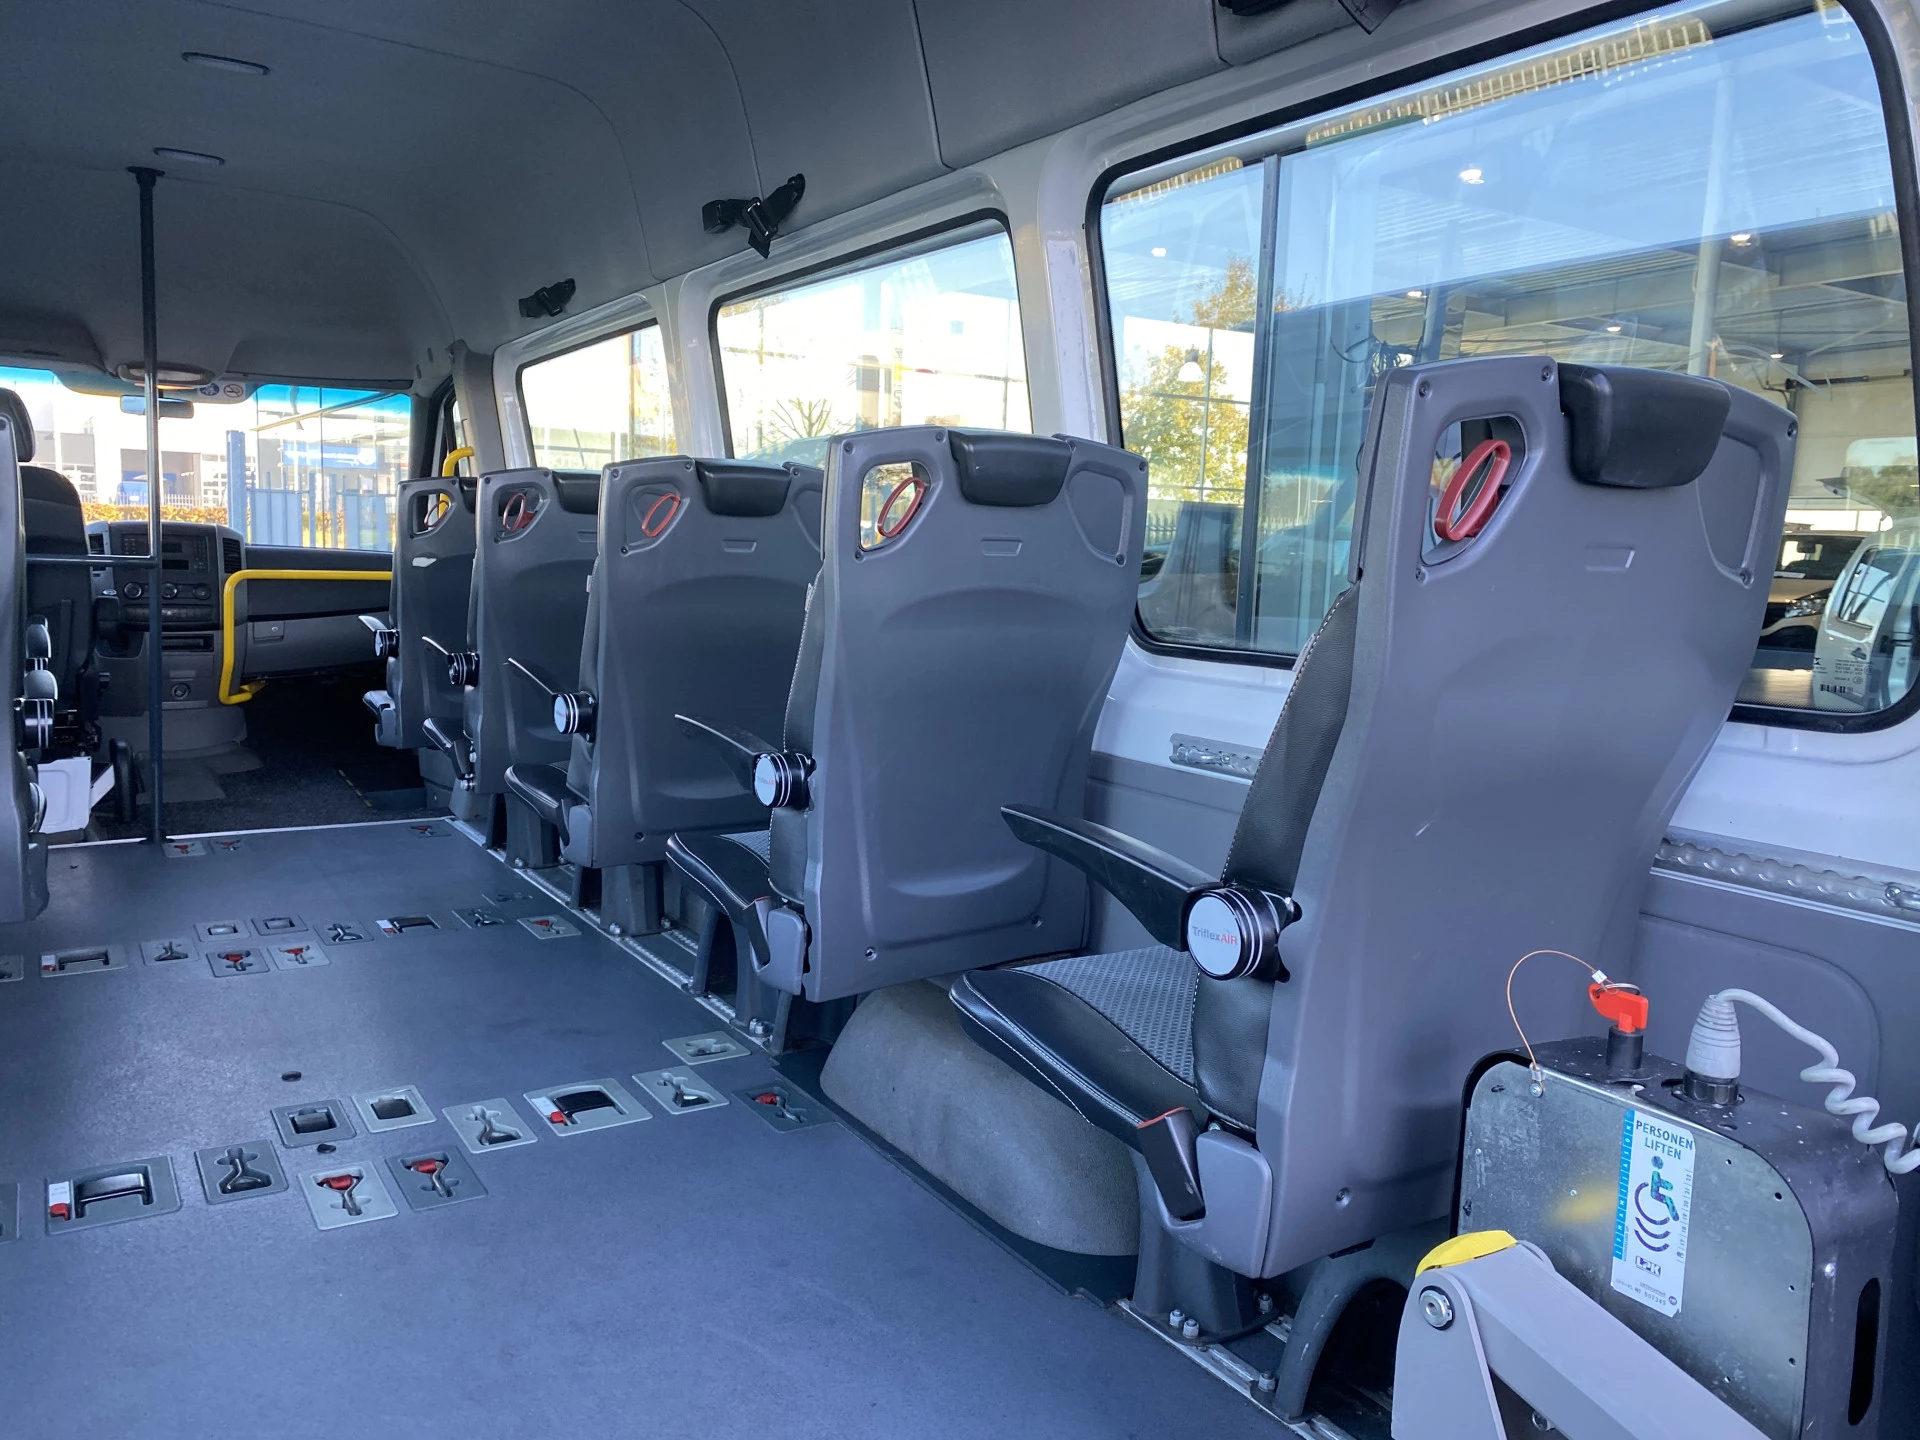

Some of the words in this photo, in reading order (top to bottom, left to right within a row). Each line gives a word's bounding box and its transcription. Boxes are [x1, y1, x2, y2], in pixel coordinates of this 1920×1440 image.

[1192, 926, 1238, 945] TriflexAIR
[1636, 1120, 1693, 1150] PERSONEN
[1644, 1137, 1682, 1160] LIFTEN
